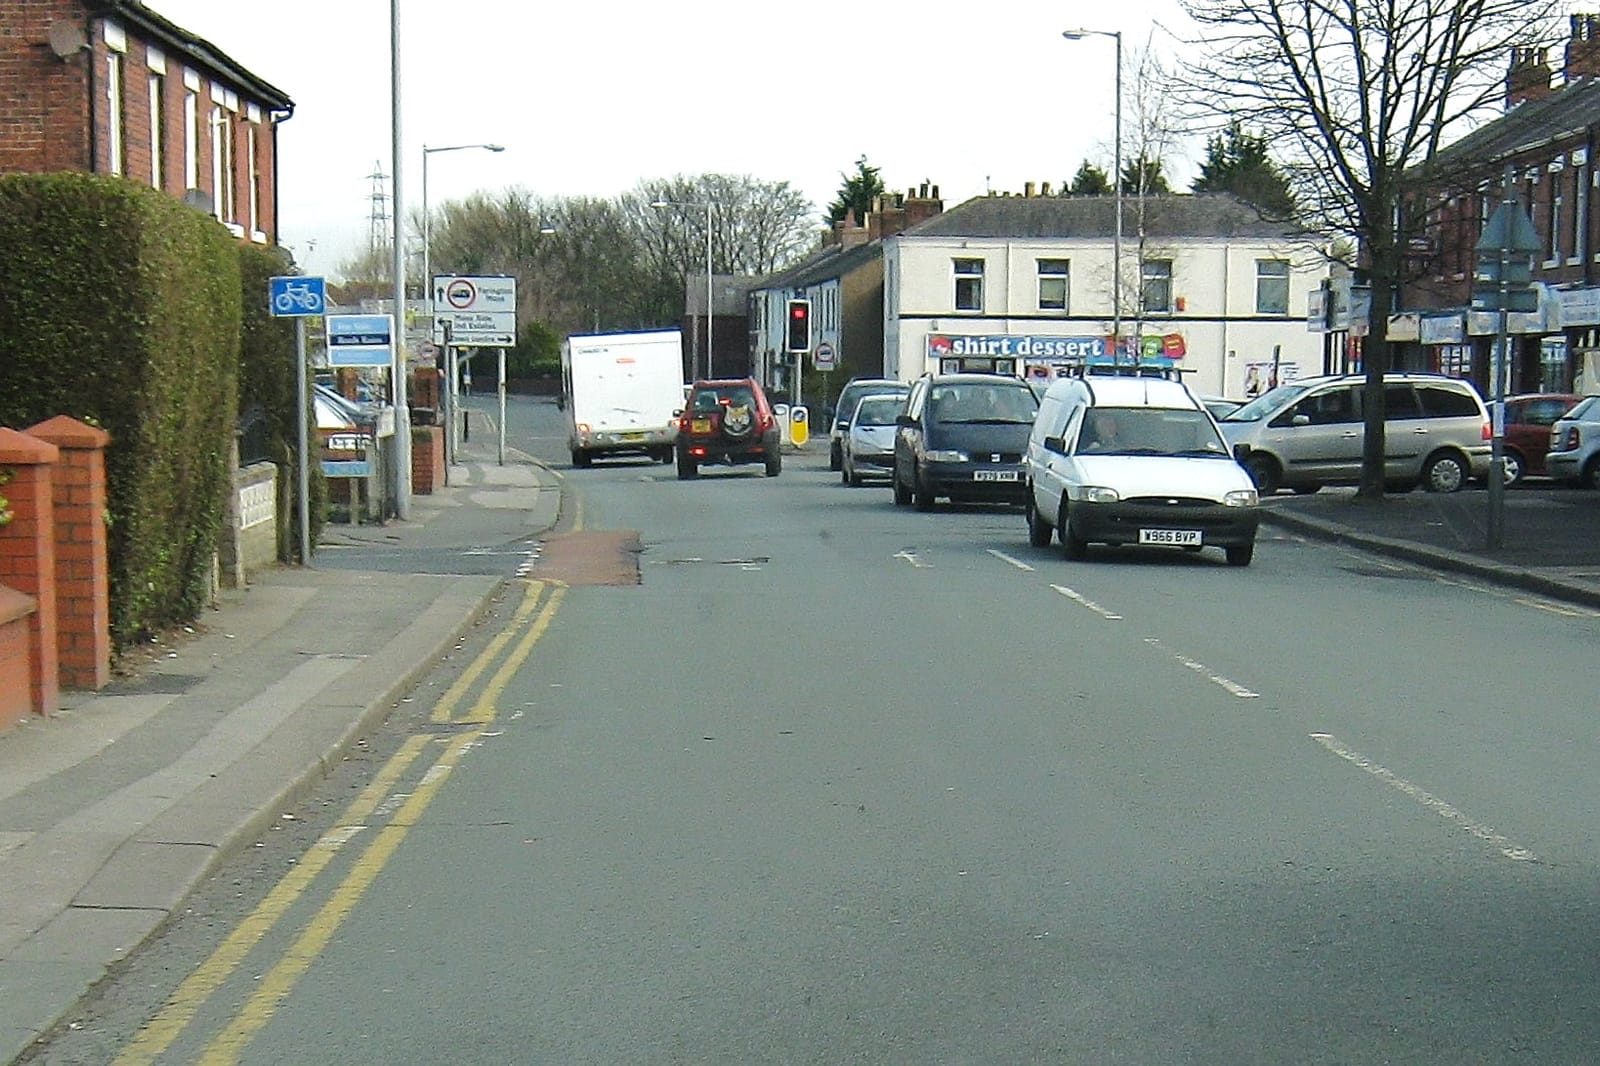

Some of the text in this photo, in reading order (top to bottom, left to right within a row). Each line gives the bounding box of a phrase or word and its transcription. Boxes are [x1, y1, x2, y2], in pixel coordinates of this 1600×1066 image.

[952, 337, 1010, 356] shirt
[1017, 336, 1103, 356] dessert
[1144, 530, 1196, 542] W966 BVP
